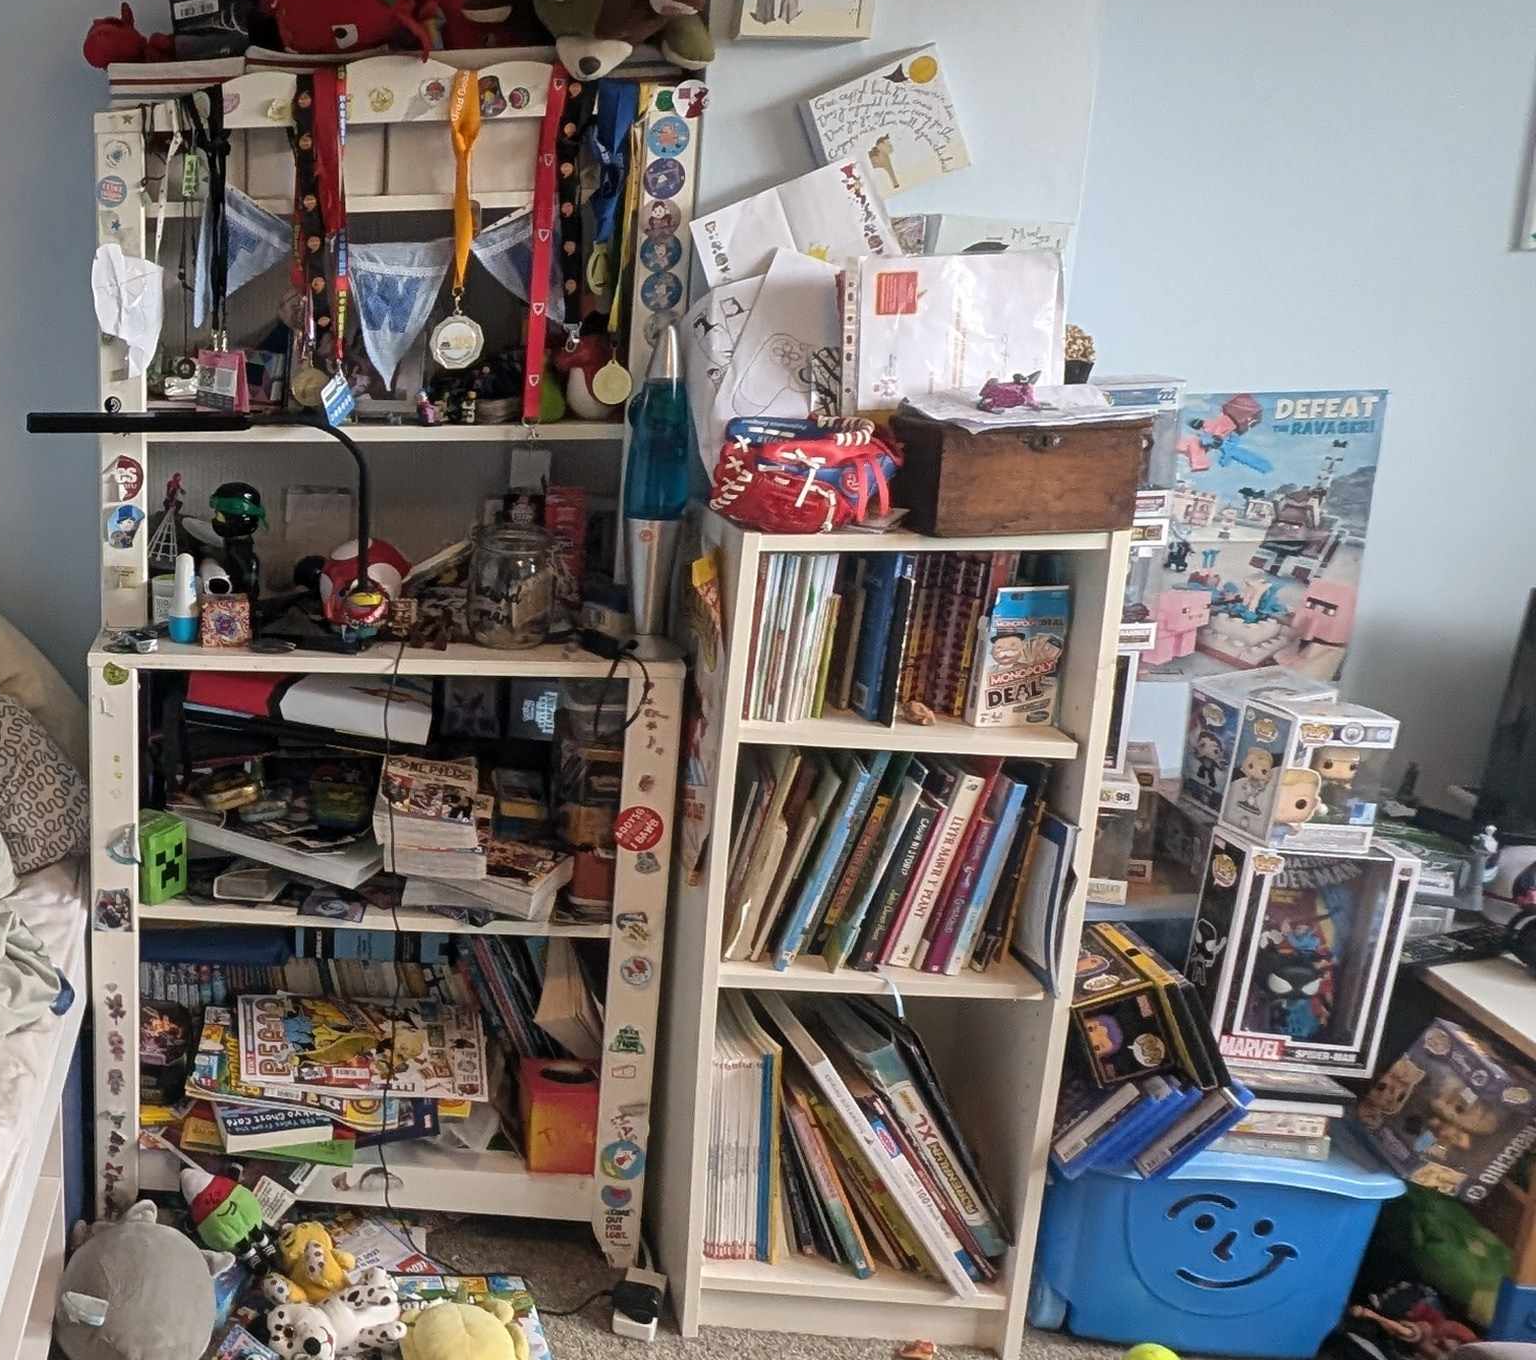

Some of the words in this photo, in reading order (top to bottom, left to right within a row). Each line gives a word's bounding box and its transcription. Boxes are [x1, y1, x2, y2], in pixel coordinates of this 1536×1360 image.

[1274, 396, 1381, 420] DEFEAT
[1291, 420, 1376, 436] RAVAGER!
[988, 660, 1057, 687] MONOPOLY
[986, 680, 1043, 709] DEAL
[1115, 791, 1131, 802] 98
[944, 815, 965, 846] LLYFR
[931, 846, 954, 878] MAWR
[928, 877, 938, 888] Y
[913, 888, 935, 920] PLANT
[1219, 1035, 1282, 1060] MARVEL
[1294, 1050, 1357, 1063] SPIDER-MAN
[254, 1112, 286, 1124] Ghost
[913, 1113, 937, 1142] XL
[605, 1216, 623, 1224] OUT
